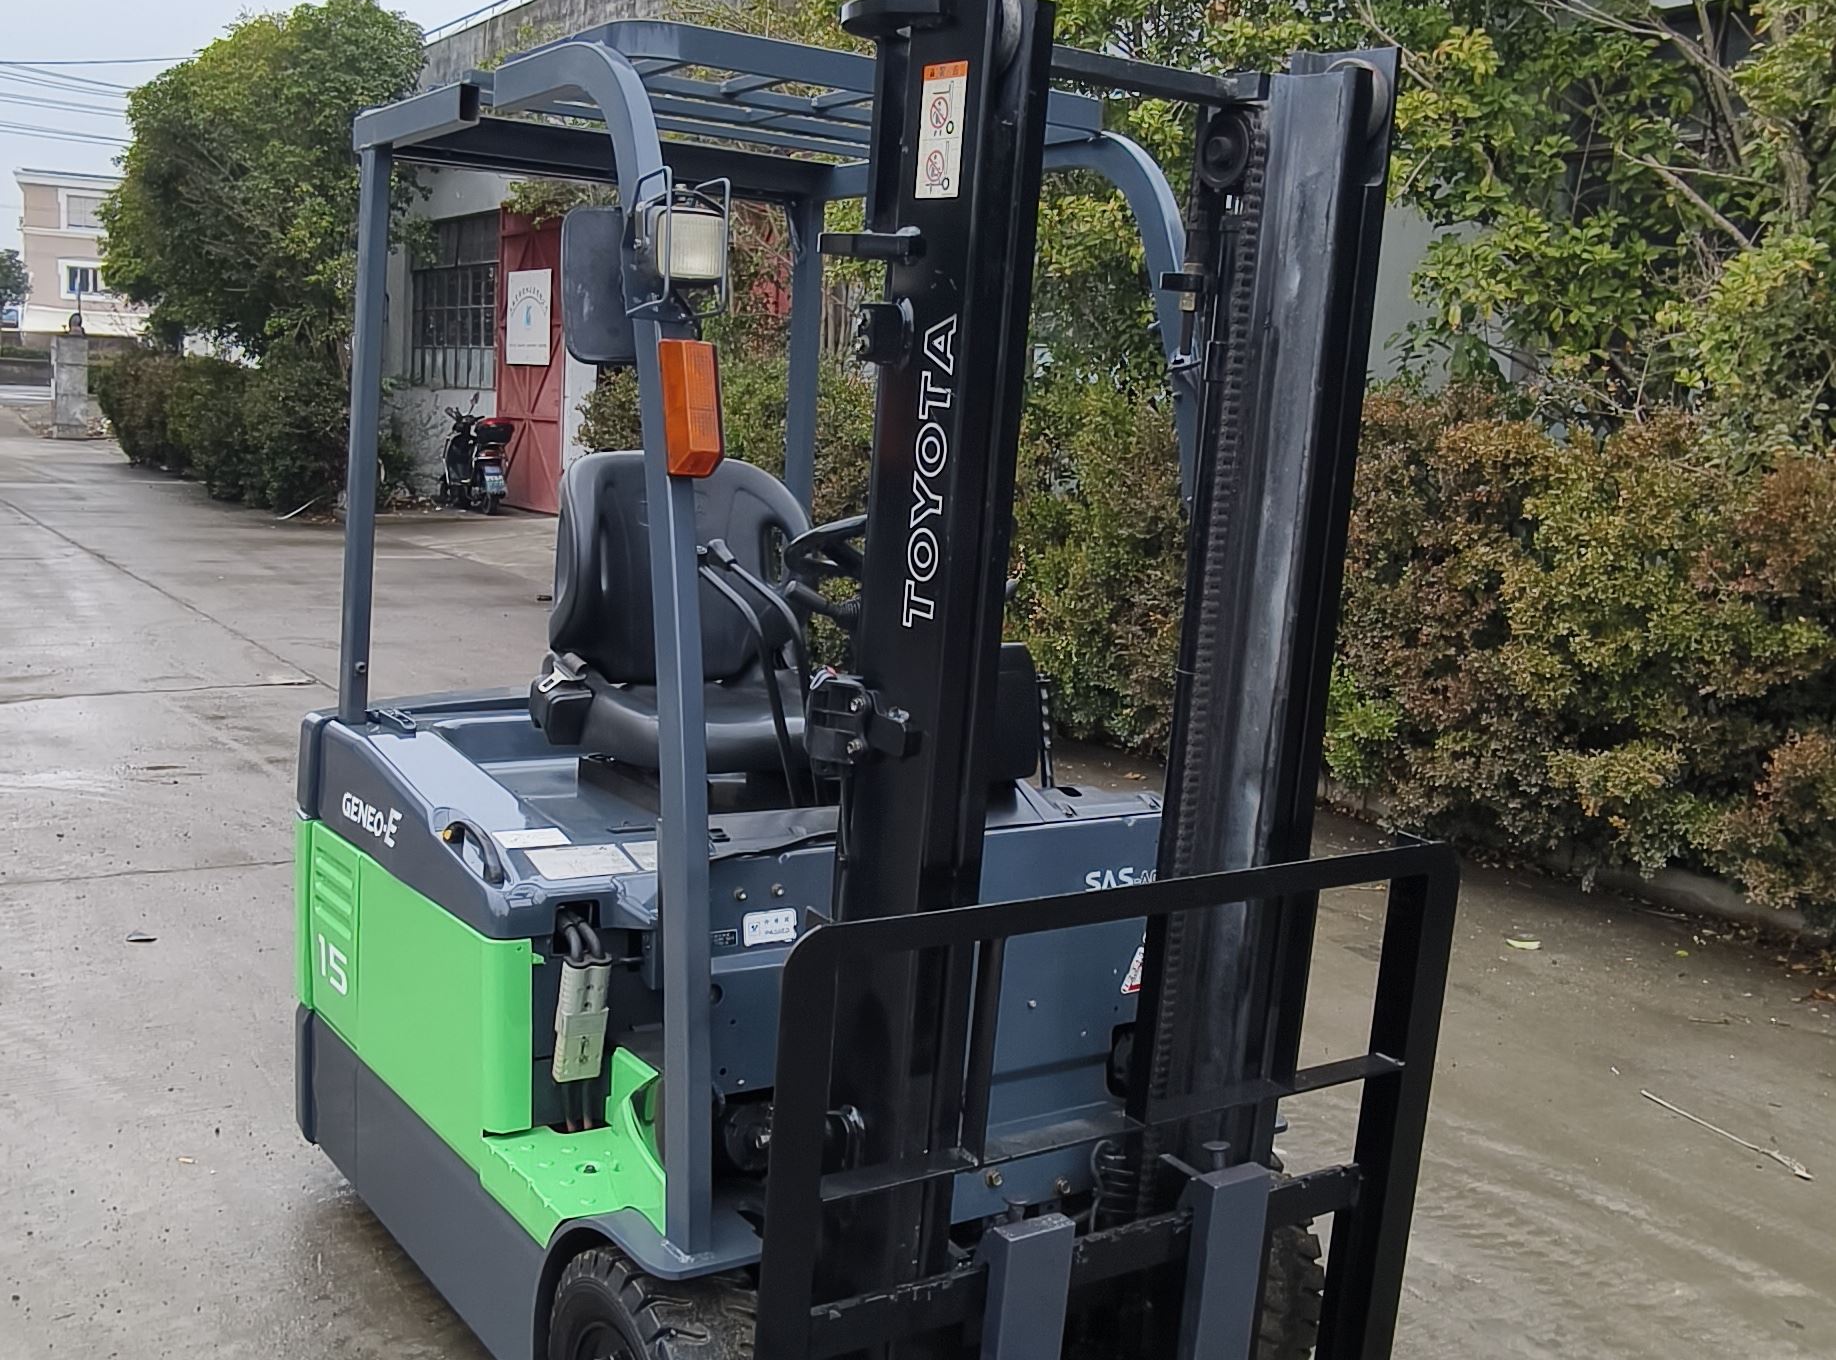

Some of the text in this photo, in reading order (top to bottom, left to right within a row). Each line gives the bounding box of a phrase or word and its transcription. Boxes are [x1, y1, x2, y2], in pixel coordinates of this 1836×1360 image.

[903, 313, 957, 627] TOYOTA
[342, 791, 403, 848] GENEO-E
[318, 932, 348, 996] 15
